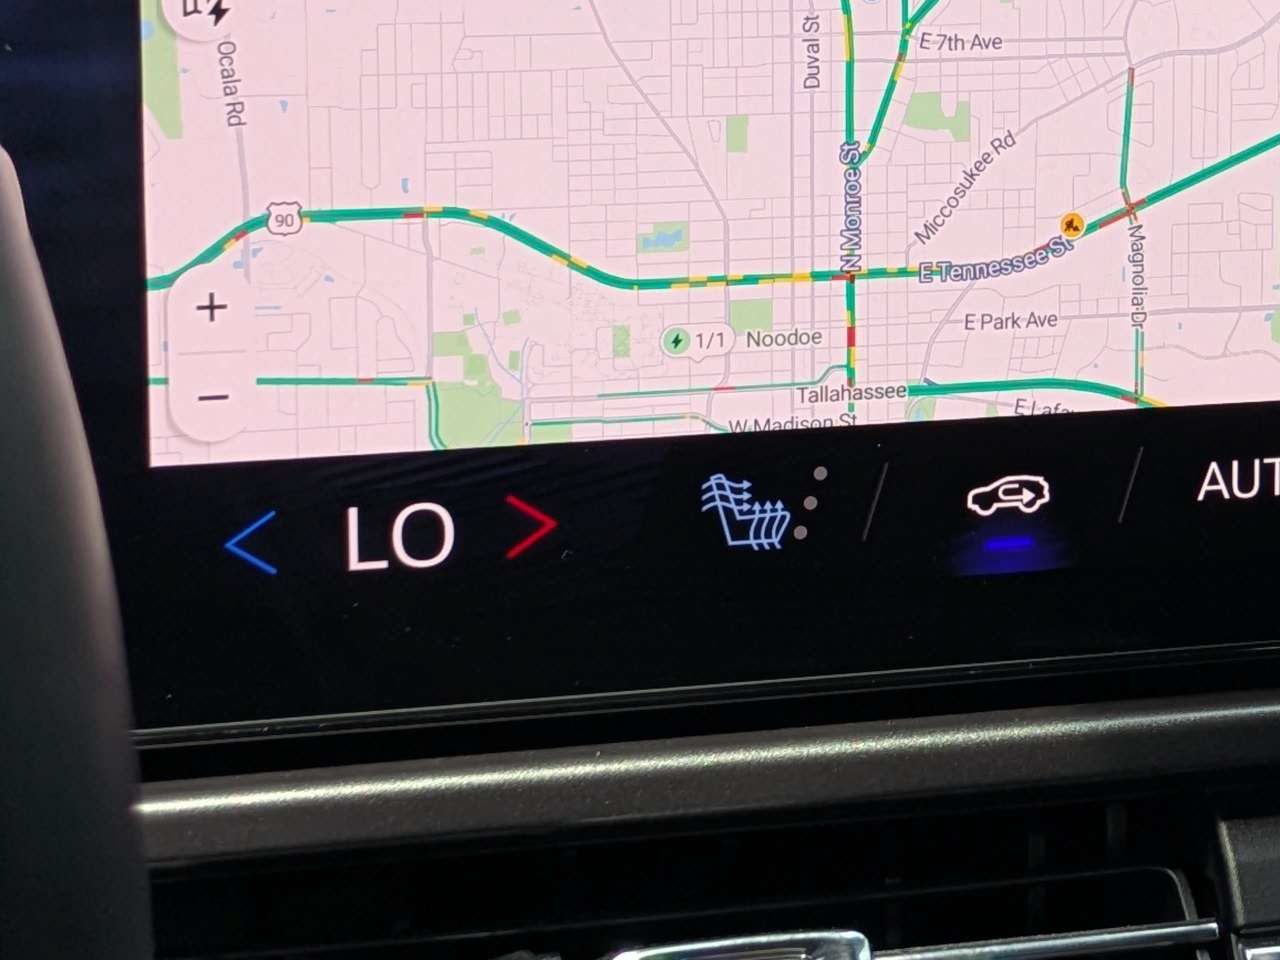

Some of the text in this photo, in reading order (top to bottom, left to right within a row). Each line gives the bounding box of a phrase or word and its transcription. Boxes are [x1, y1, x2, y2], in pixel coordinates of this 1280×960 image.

[803, 15, 820, 89] Duval St
[920, 33, 1002, 51] E 7th Ave
[217, 41, 247, 127] Ocala Rd
[914, 131, 1017, 245] Miccosukee Rd
[839, 141, 862, 272] N Monroe St
[275, 213, 294, 227] 90
[918, 235, 1075, 283] E Tennessee St
[1127, 225, 1149, 330] Magnolia Dr
[964, 312, 1058, 331] E Park Ave
[696, 332, 724, 350] 1/1
[747, 328, 822, 347] Noodoe
[797, 384, 907, 404] Tallahassee
[1014, 398, 1027, 415] E
[728, 413, 856, 432] W Madison St
[347, 502, 455, 571] LO
